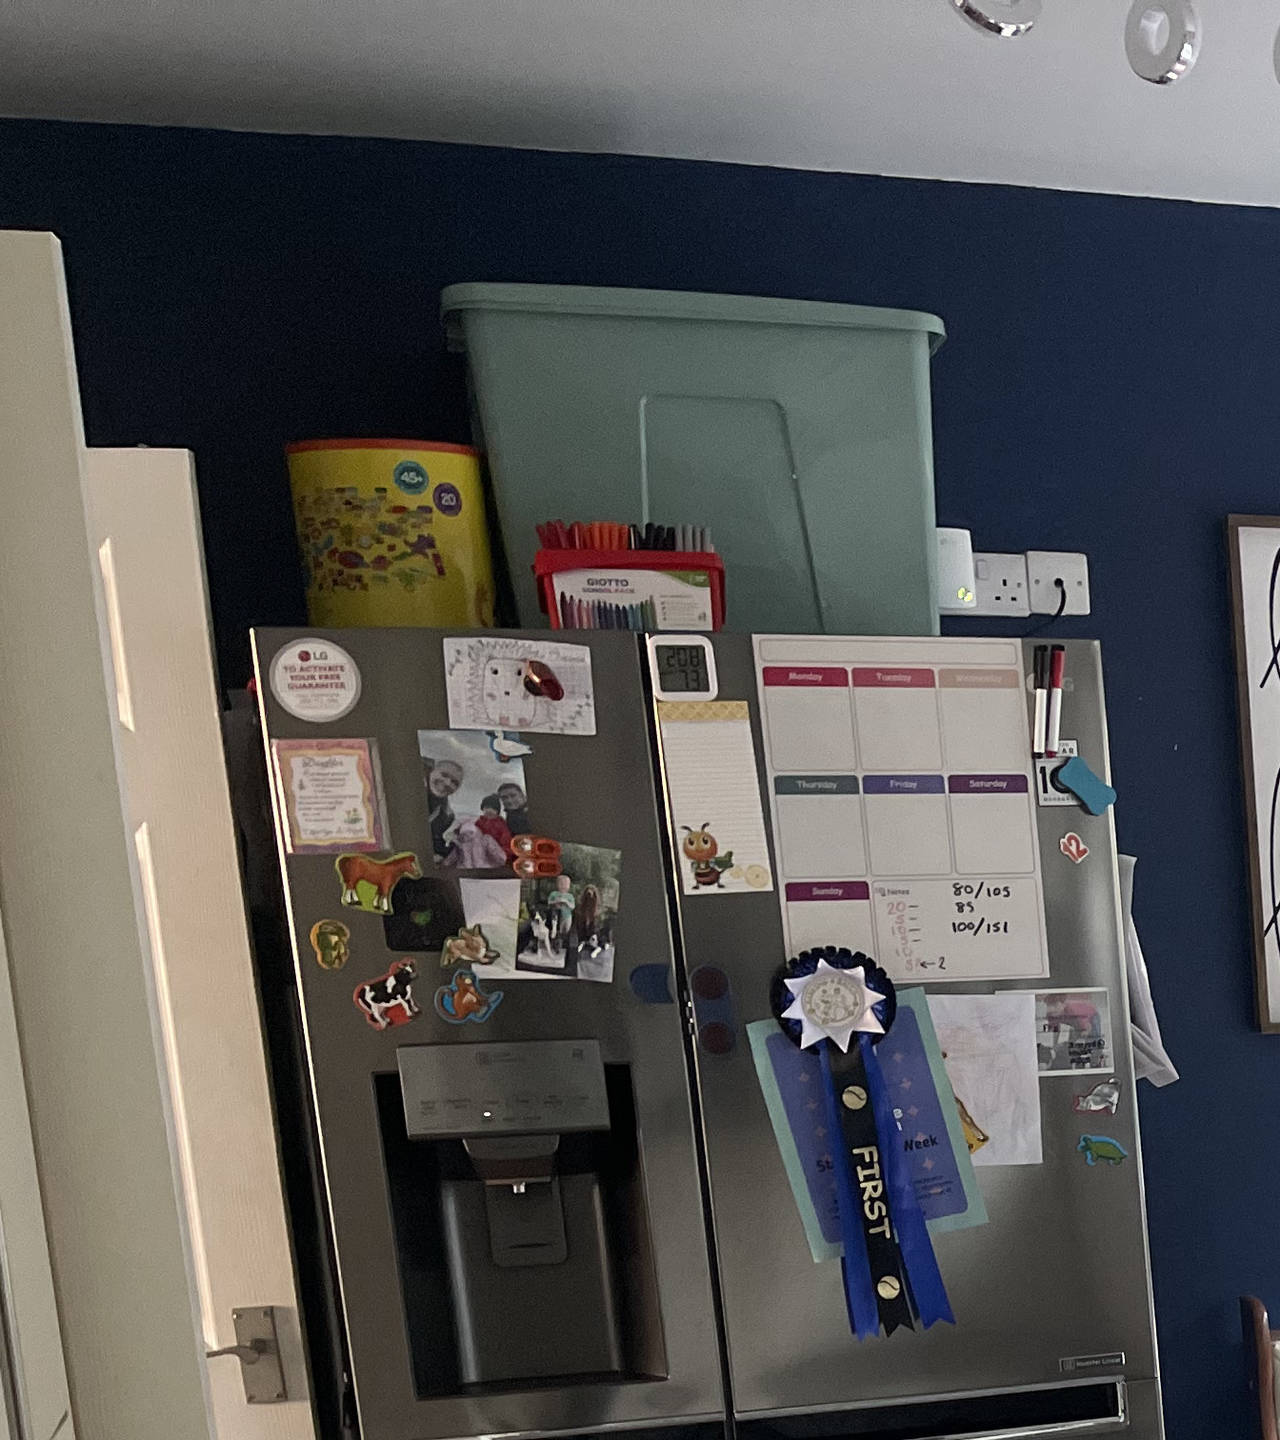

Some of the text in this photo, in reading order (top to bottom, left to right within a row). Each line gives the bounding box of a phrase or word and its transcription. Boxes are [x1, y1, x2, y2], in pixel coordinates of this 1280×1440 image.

[400, 471, 423, 484] 45+
[440, 492, 457, 506] 20
[587, 578, 629, 587] GIOTTO
[313, 651, 328, 661] LG
[788, 672, 823, 682] Monday
[876, 673, 912, 682] Tuesday
[797, 779, 838, 790] Thursday
[889, 779, 918, 790] Friday
[969, 779, 1008, 790] Saturday
[812, 887, 843, 896] Sunday
[952, 881, 1011, 899] 80/105
[955, 902, 975, 913] 85
[852, 1145, 891, 1239] FIRST
